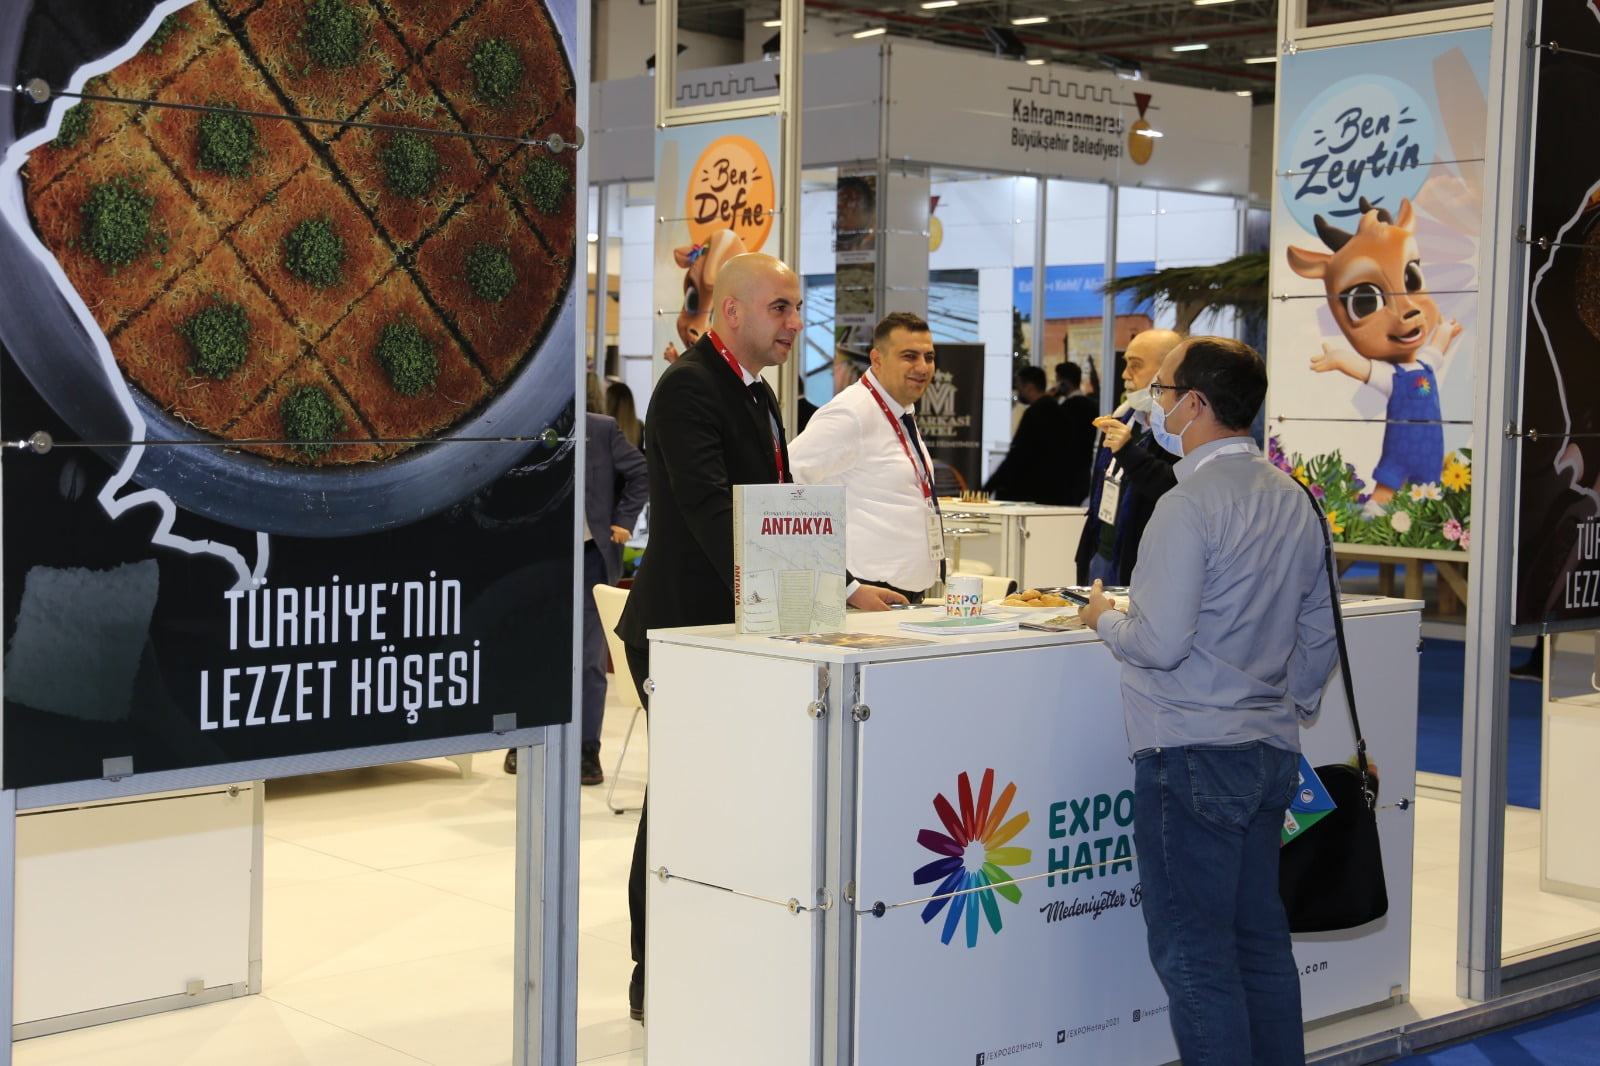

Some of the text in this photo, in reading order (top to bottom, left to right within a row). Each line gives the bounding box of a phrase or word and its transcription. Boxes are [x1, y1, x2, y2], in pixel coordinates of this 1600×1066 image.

[1012, 98, 1125, 138] Kahramanmaraş
[1328, 107, 1391, 154] Ben
[1011, 128, 1124, 160] Büyükşehir Belediyesi
[710, 158, 747, 192] Ben
[1295, 135, 1420, 203] Zeytin
[694, 187, 764, 231] Defne
[761, 518, 833, 535] ANTAKYA
[200, 640, 480, 730] LEZZET KÖŞESİ
[1049, 789, 1135, 839] EXPO
[1048, 832, 1138, 888] HATA
[1040, 889, 1127, 924] Medeniyetler
[1299, 961, 1328, 976] .com
